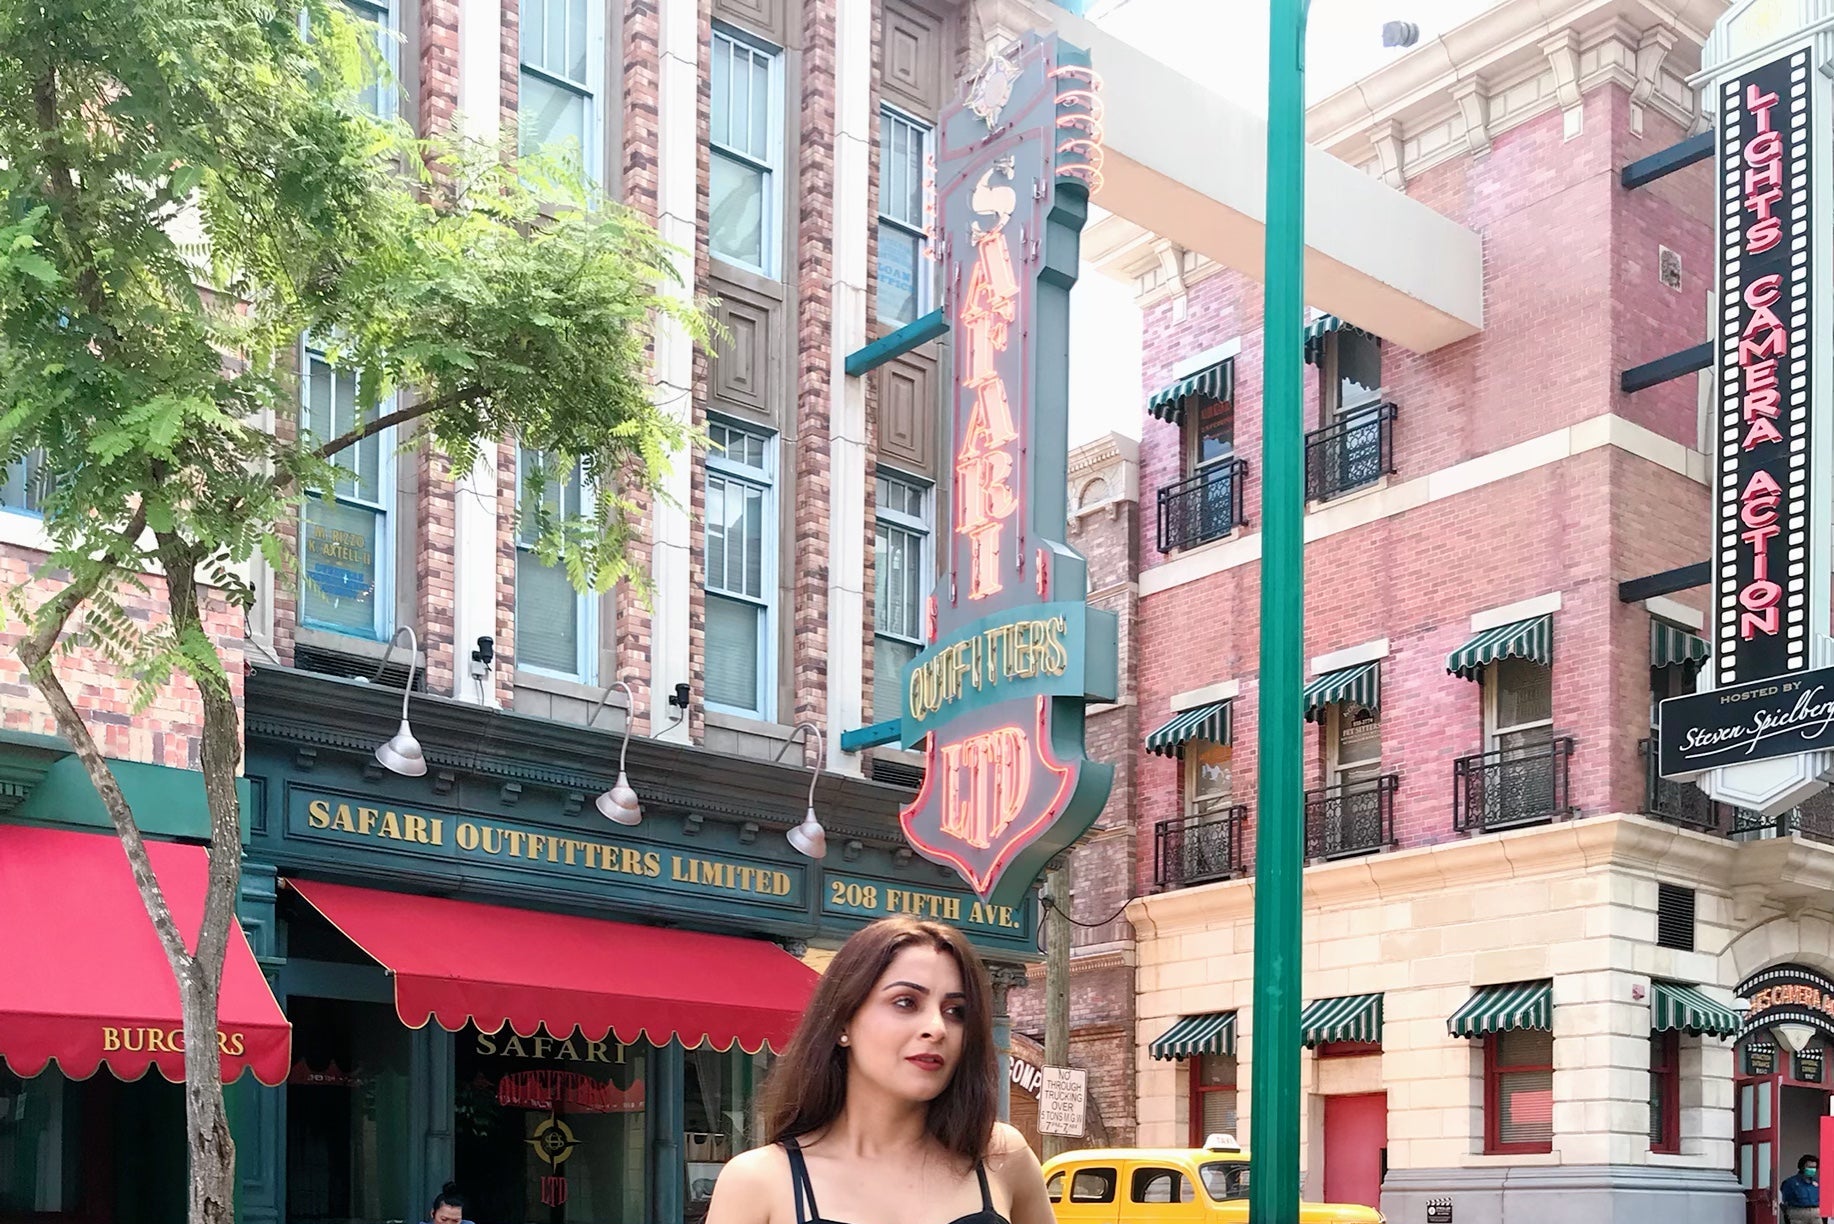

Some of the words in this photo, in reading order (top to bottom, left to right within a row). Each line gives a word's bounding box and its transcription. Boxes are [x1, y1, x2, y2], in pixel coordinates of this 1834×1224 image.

[1744, 83, 1784, 256] LIGHTS
[956, 154, 1021, 600] SAFARI
[1738, 273, 1788, 452] CAMERA
[323, 543, 360, 562] AXTELL
[332, 529, 365, 548] RIZZO
[1739, 469, 1783, 641] ACTION
[909, 614, 1068, 722] OUTFITTERS
[1720, 686, 1779, 705] HOSTED
[1782, 681, 1803, 693] BY
[1679, 726, 1746, 752] Steven
[940, 726, 1031, 849] LTD
[308, 799, 444, 846] SAFARI
[455, 822, 662, 878] OUTFITTERS
[671, 855, 792, 896] LIMITED
[831, 880, 878, 910] 208
[885, 888, 961, 921] FIFTH
[967, 901, 1021, 929] AVE.
[1771, 984, 1821, 1011] CAMERA
[102, 1026, 245, 1056] BURGRS
[476, 1033, 627, 1065] SAFARI
[1047, 1079, 1082, 1092] THROUGH
[1058, 1069, 1071, 1081] NO
[1044, 1090, 1083, 1103] TRUCKING
[1051, 1101, 1074, 1112] OVER
[540, 1175, 569, 1208] LTD
